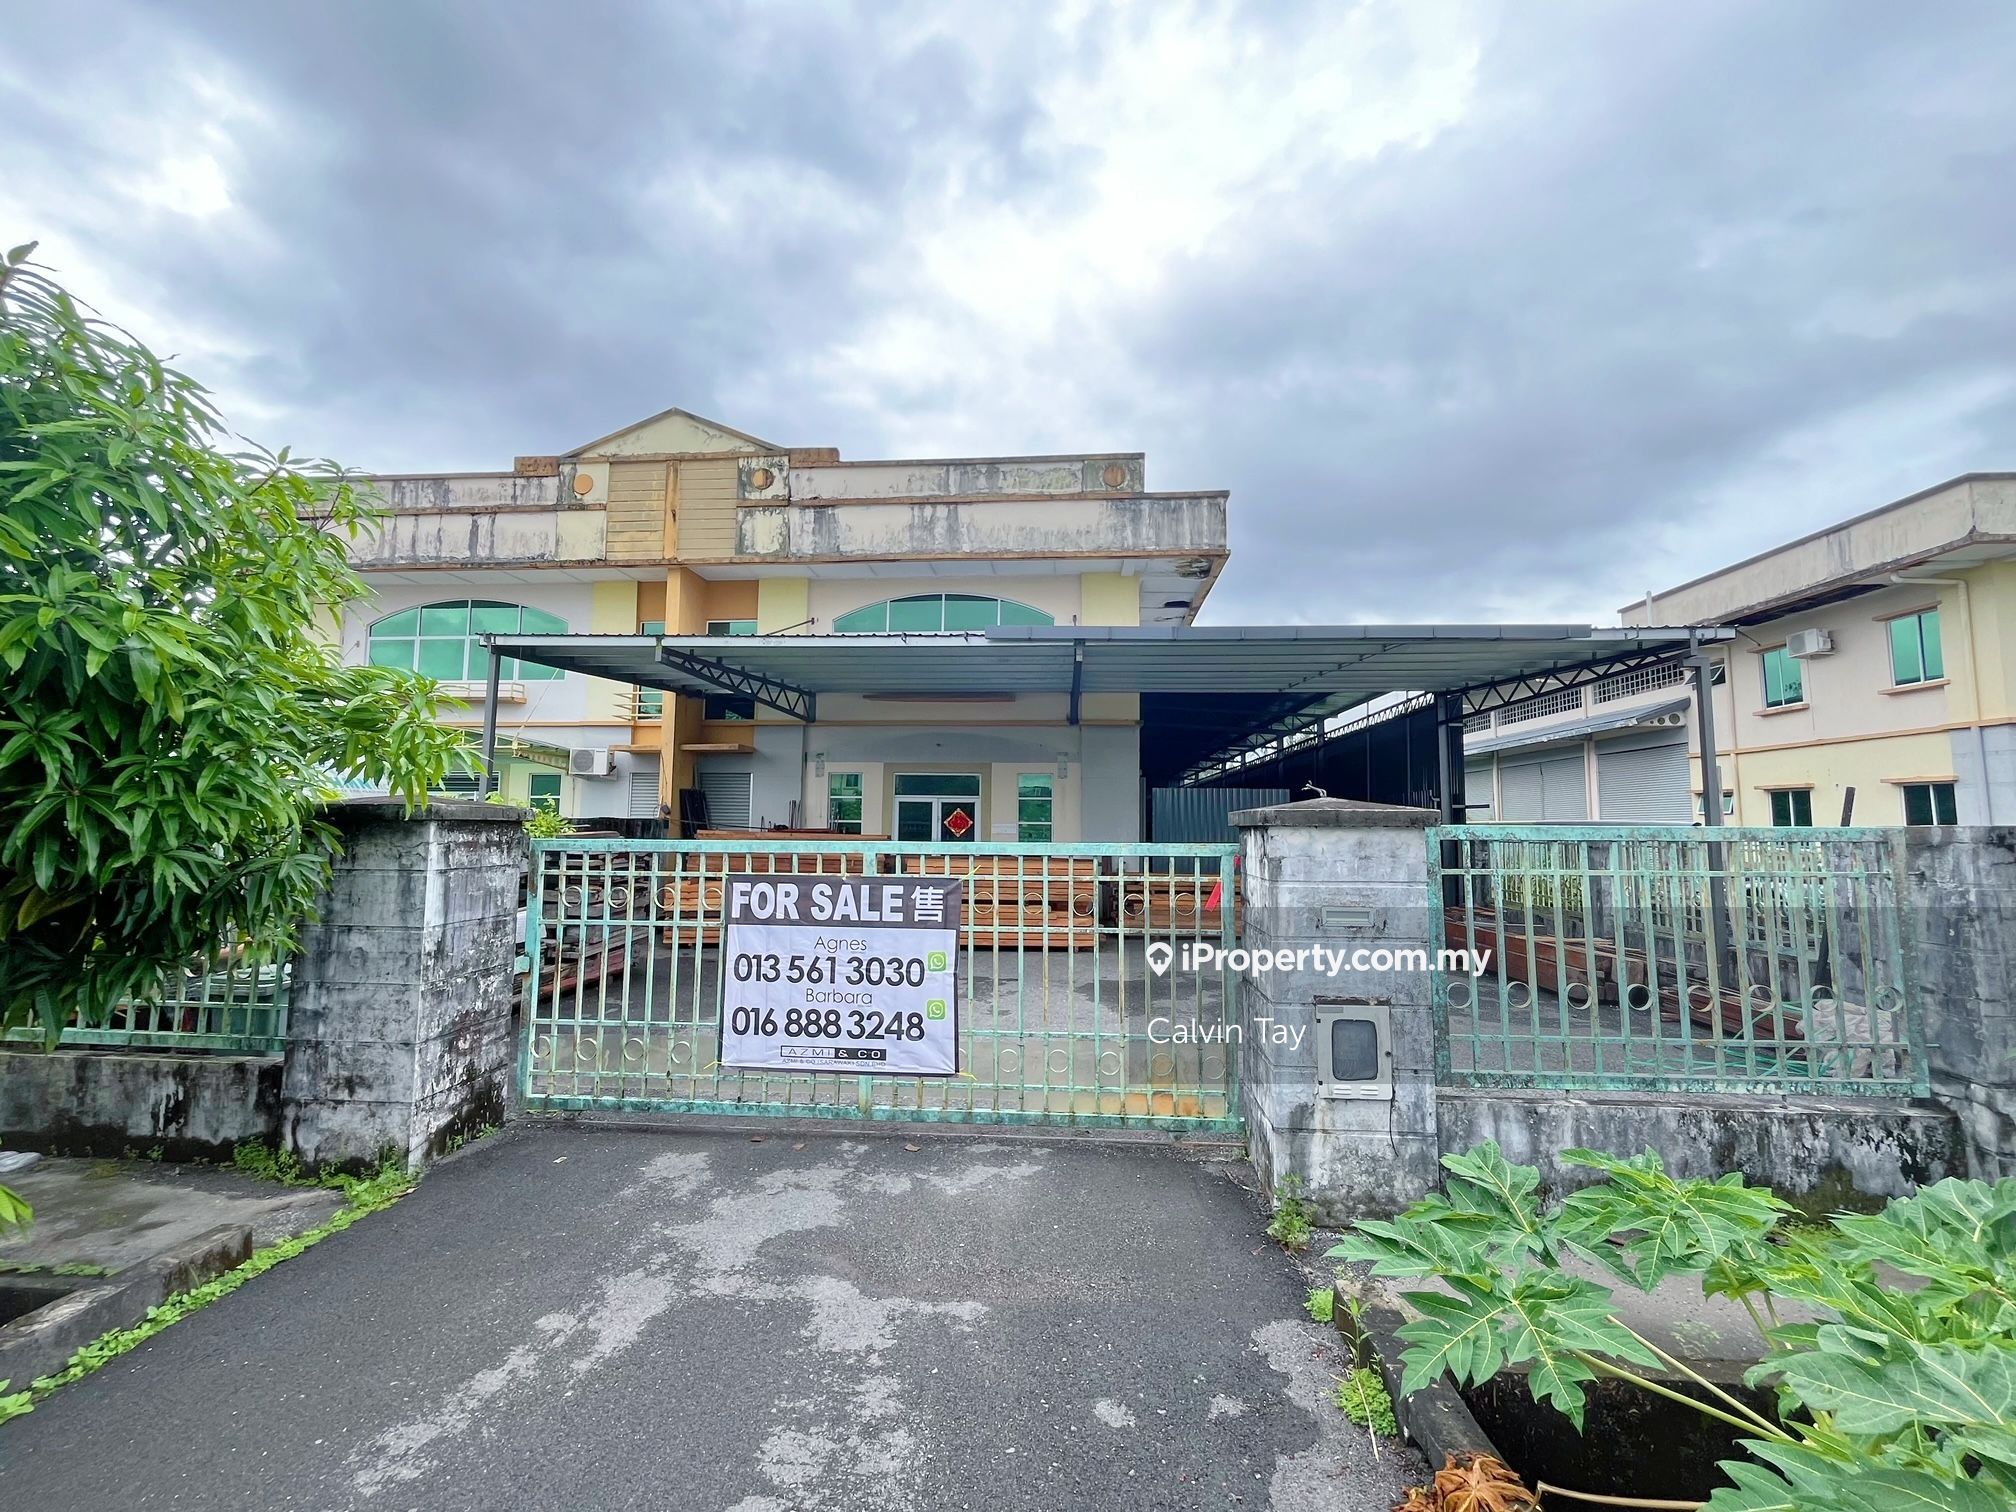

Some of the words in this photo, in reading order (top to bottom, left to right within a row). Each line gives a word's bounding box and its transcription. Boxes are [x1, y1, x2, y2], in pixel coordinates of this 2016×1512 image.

[731, 882, 800, 920] FOR
[810, 883, 904, 922] SALE
[910, 885, 945, 923] 售
[813, 935, 867, 953] Agnes
[733, 952, 781, 983] 013
[786, 955, 836, 984] 561
[845, 956, 926, 987] 3030
[805, 988, 873, 1005] Barbara
[731, 1006, 779, 1037] 016
[784, 1007, 842, 1039] 888
[846, 1010, 926, 1042] 3248
[788, 1047, 831, 1056] AZMI
[838, 1049, 849, 1058] &
[857, 1050, 881, 1059] CO
